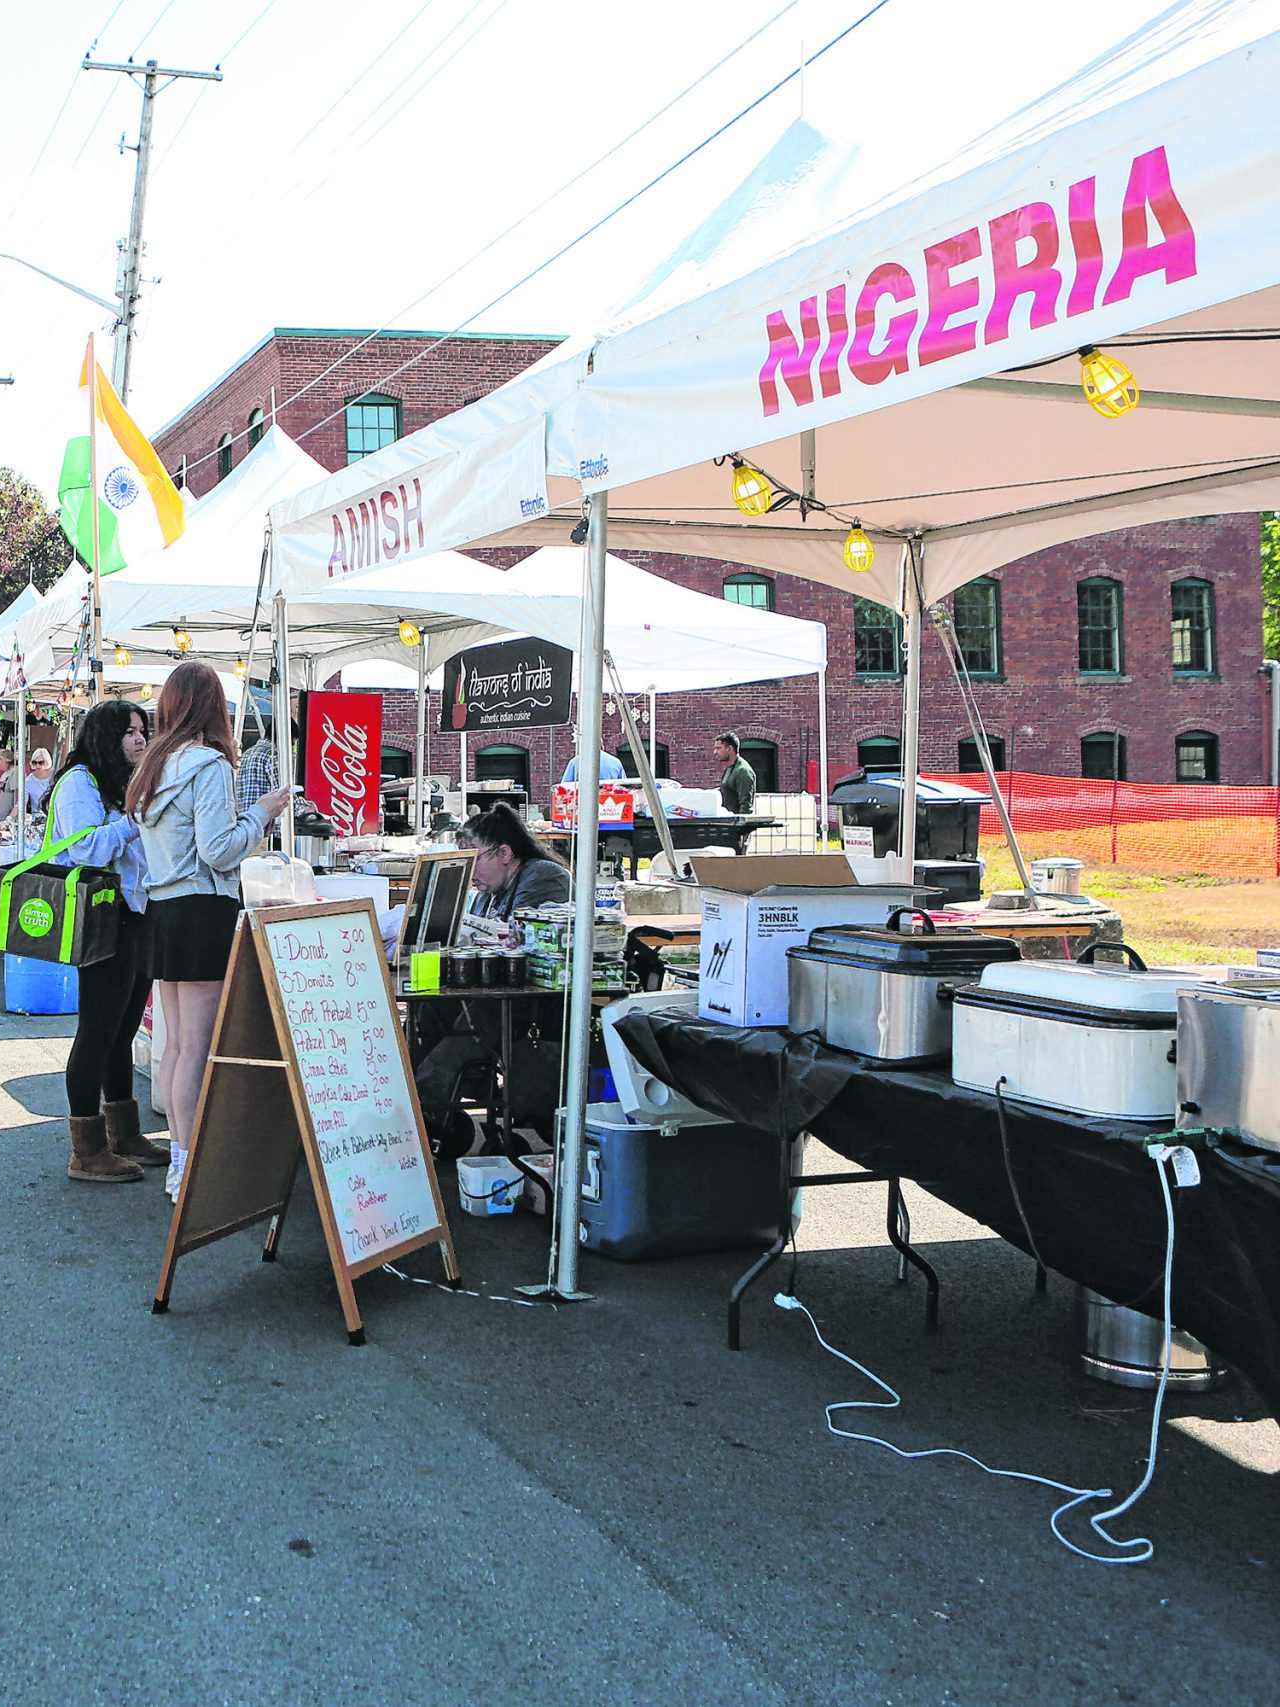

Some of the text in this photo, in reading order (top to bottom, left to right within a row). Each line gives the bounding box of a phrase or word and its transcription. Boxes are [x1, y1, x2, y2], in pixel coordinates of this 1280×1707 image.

[758, 144, 1198, 418] NIGERIA
[328, 477, 424, 578] AMISH
[468, 656, 552, 698] flavors of india
[480, 712, 530, 724] authentic indian cuisine
[24, 916, 48, 928] truth
[25, 908, 49, 919] simple
[758, 913, 799, 922] 3HNBLK
[338, 929, 364, 953] 3.00
[279, 960, 366, 993] 3-Donuts 8.00
[288, 999, 376, 1025] Soft Pretzel 5.00
[328, 1028, 346, 1055] Dog
[362, 1027, 384, 1056] 5.00
[305, 1082, 337, 1109] Pumpkin
[398, 1155, 417, 1170] Water
[348, 1175, 366, 1192] Coke
[345, 1226, 378, 1254] Thank
[399, 1209, 420, 1233] Enjoy
